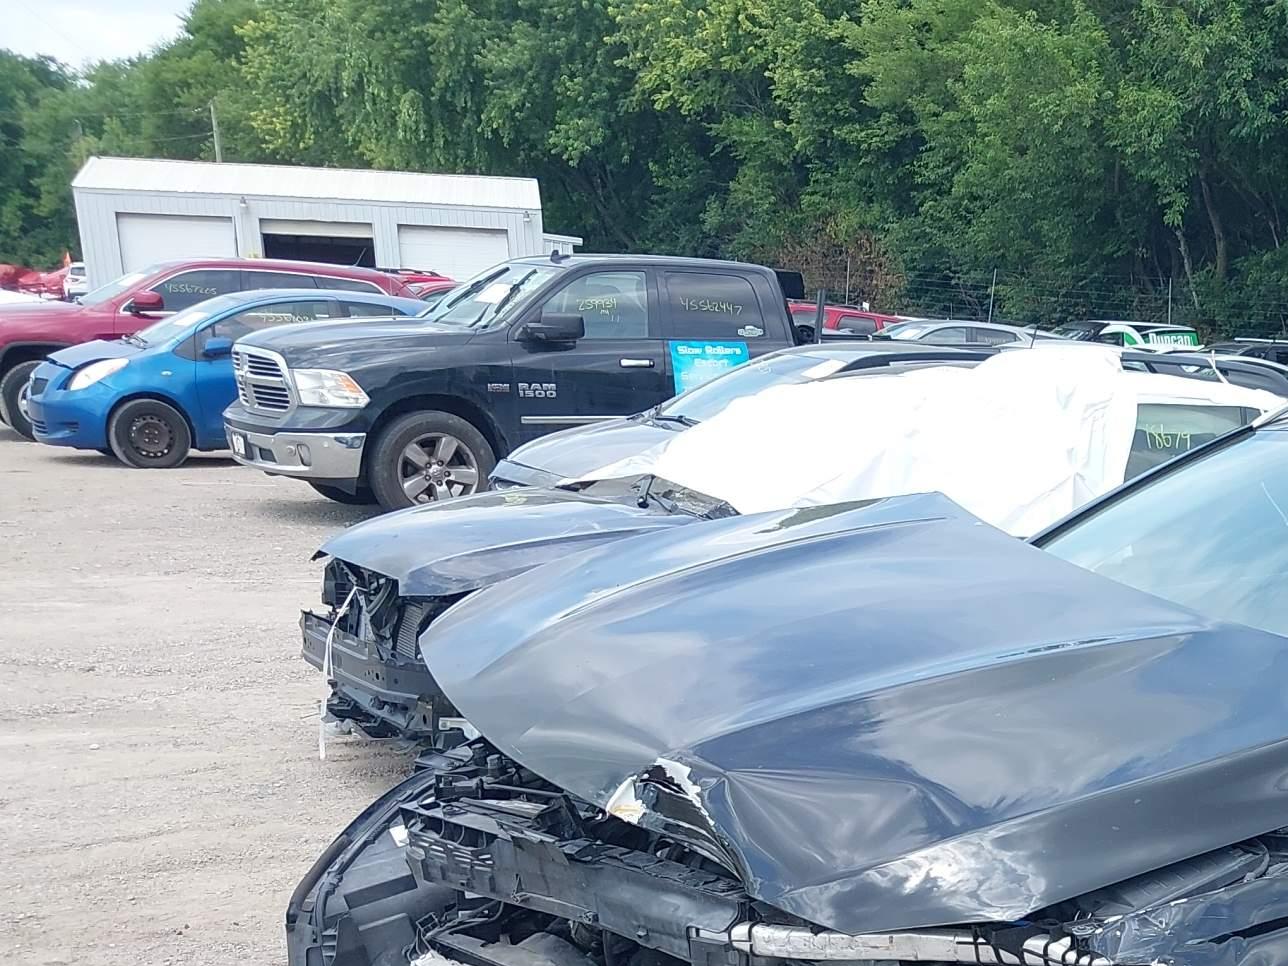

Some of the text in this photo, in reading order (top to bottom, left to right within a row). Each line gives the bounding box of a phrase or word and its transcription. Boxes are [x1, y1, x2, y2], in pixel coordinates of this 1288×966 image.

[680, 297, 743, 316] 45562447
[518, 383, 557, 391] RAM
[519, 390, 557, 398] 1500
